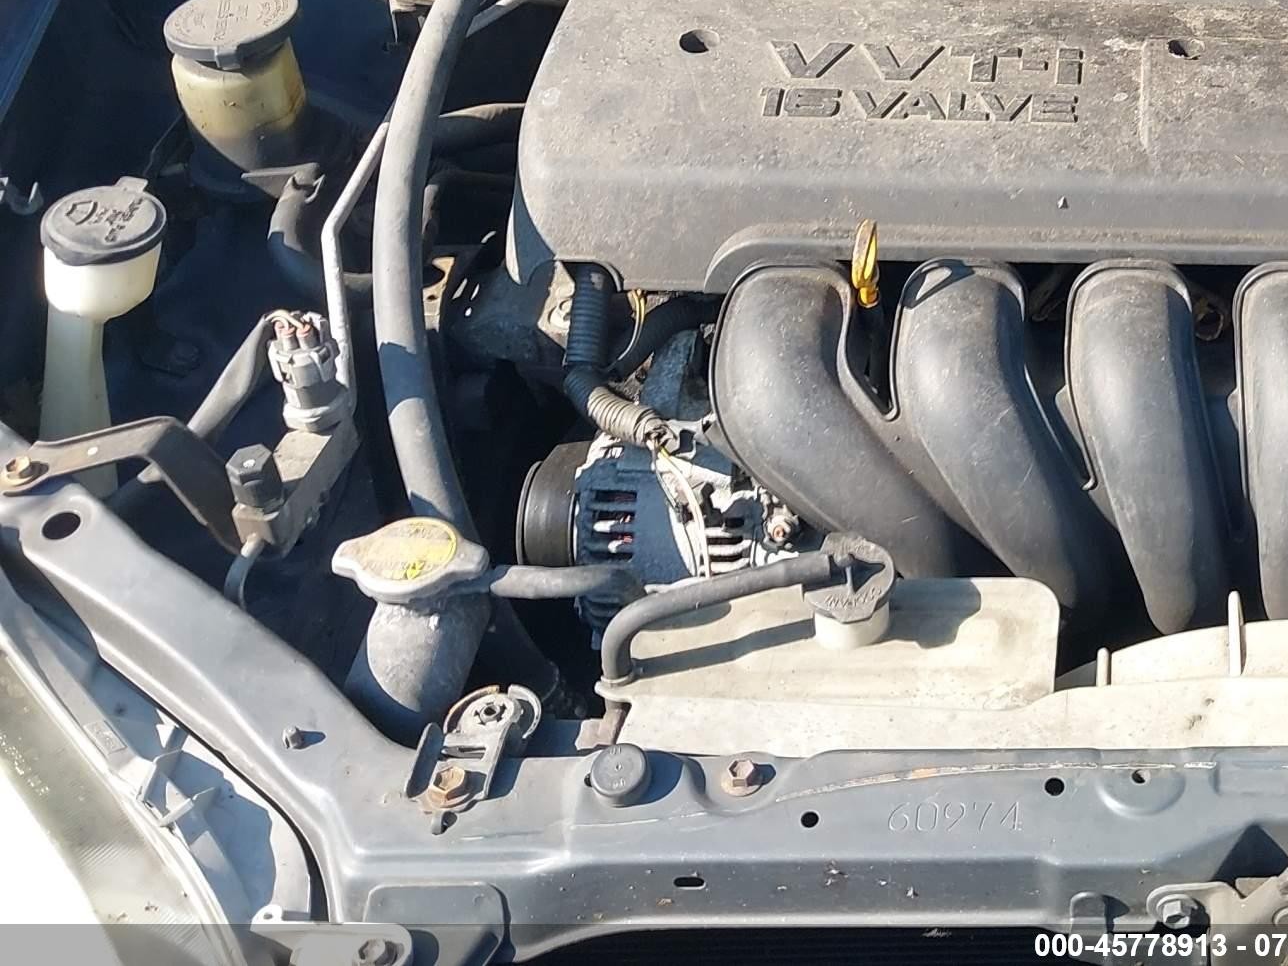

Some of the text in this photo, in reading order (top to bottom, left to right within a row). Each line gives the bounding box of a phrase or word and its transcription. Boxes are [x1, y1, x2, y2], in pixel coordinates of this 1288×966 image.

[760, 88, 1079, 124] 16 VALVE
[887, 801, 1021, 833] 60974
